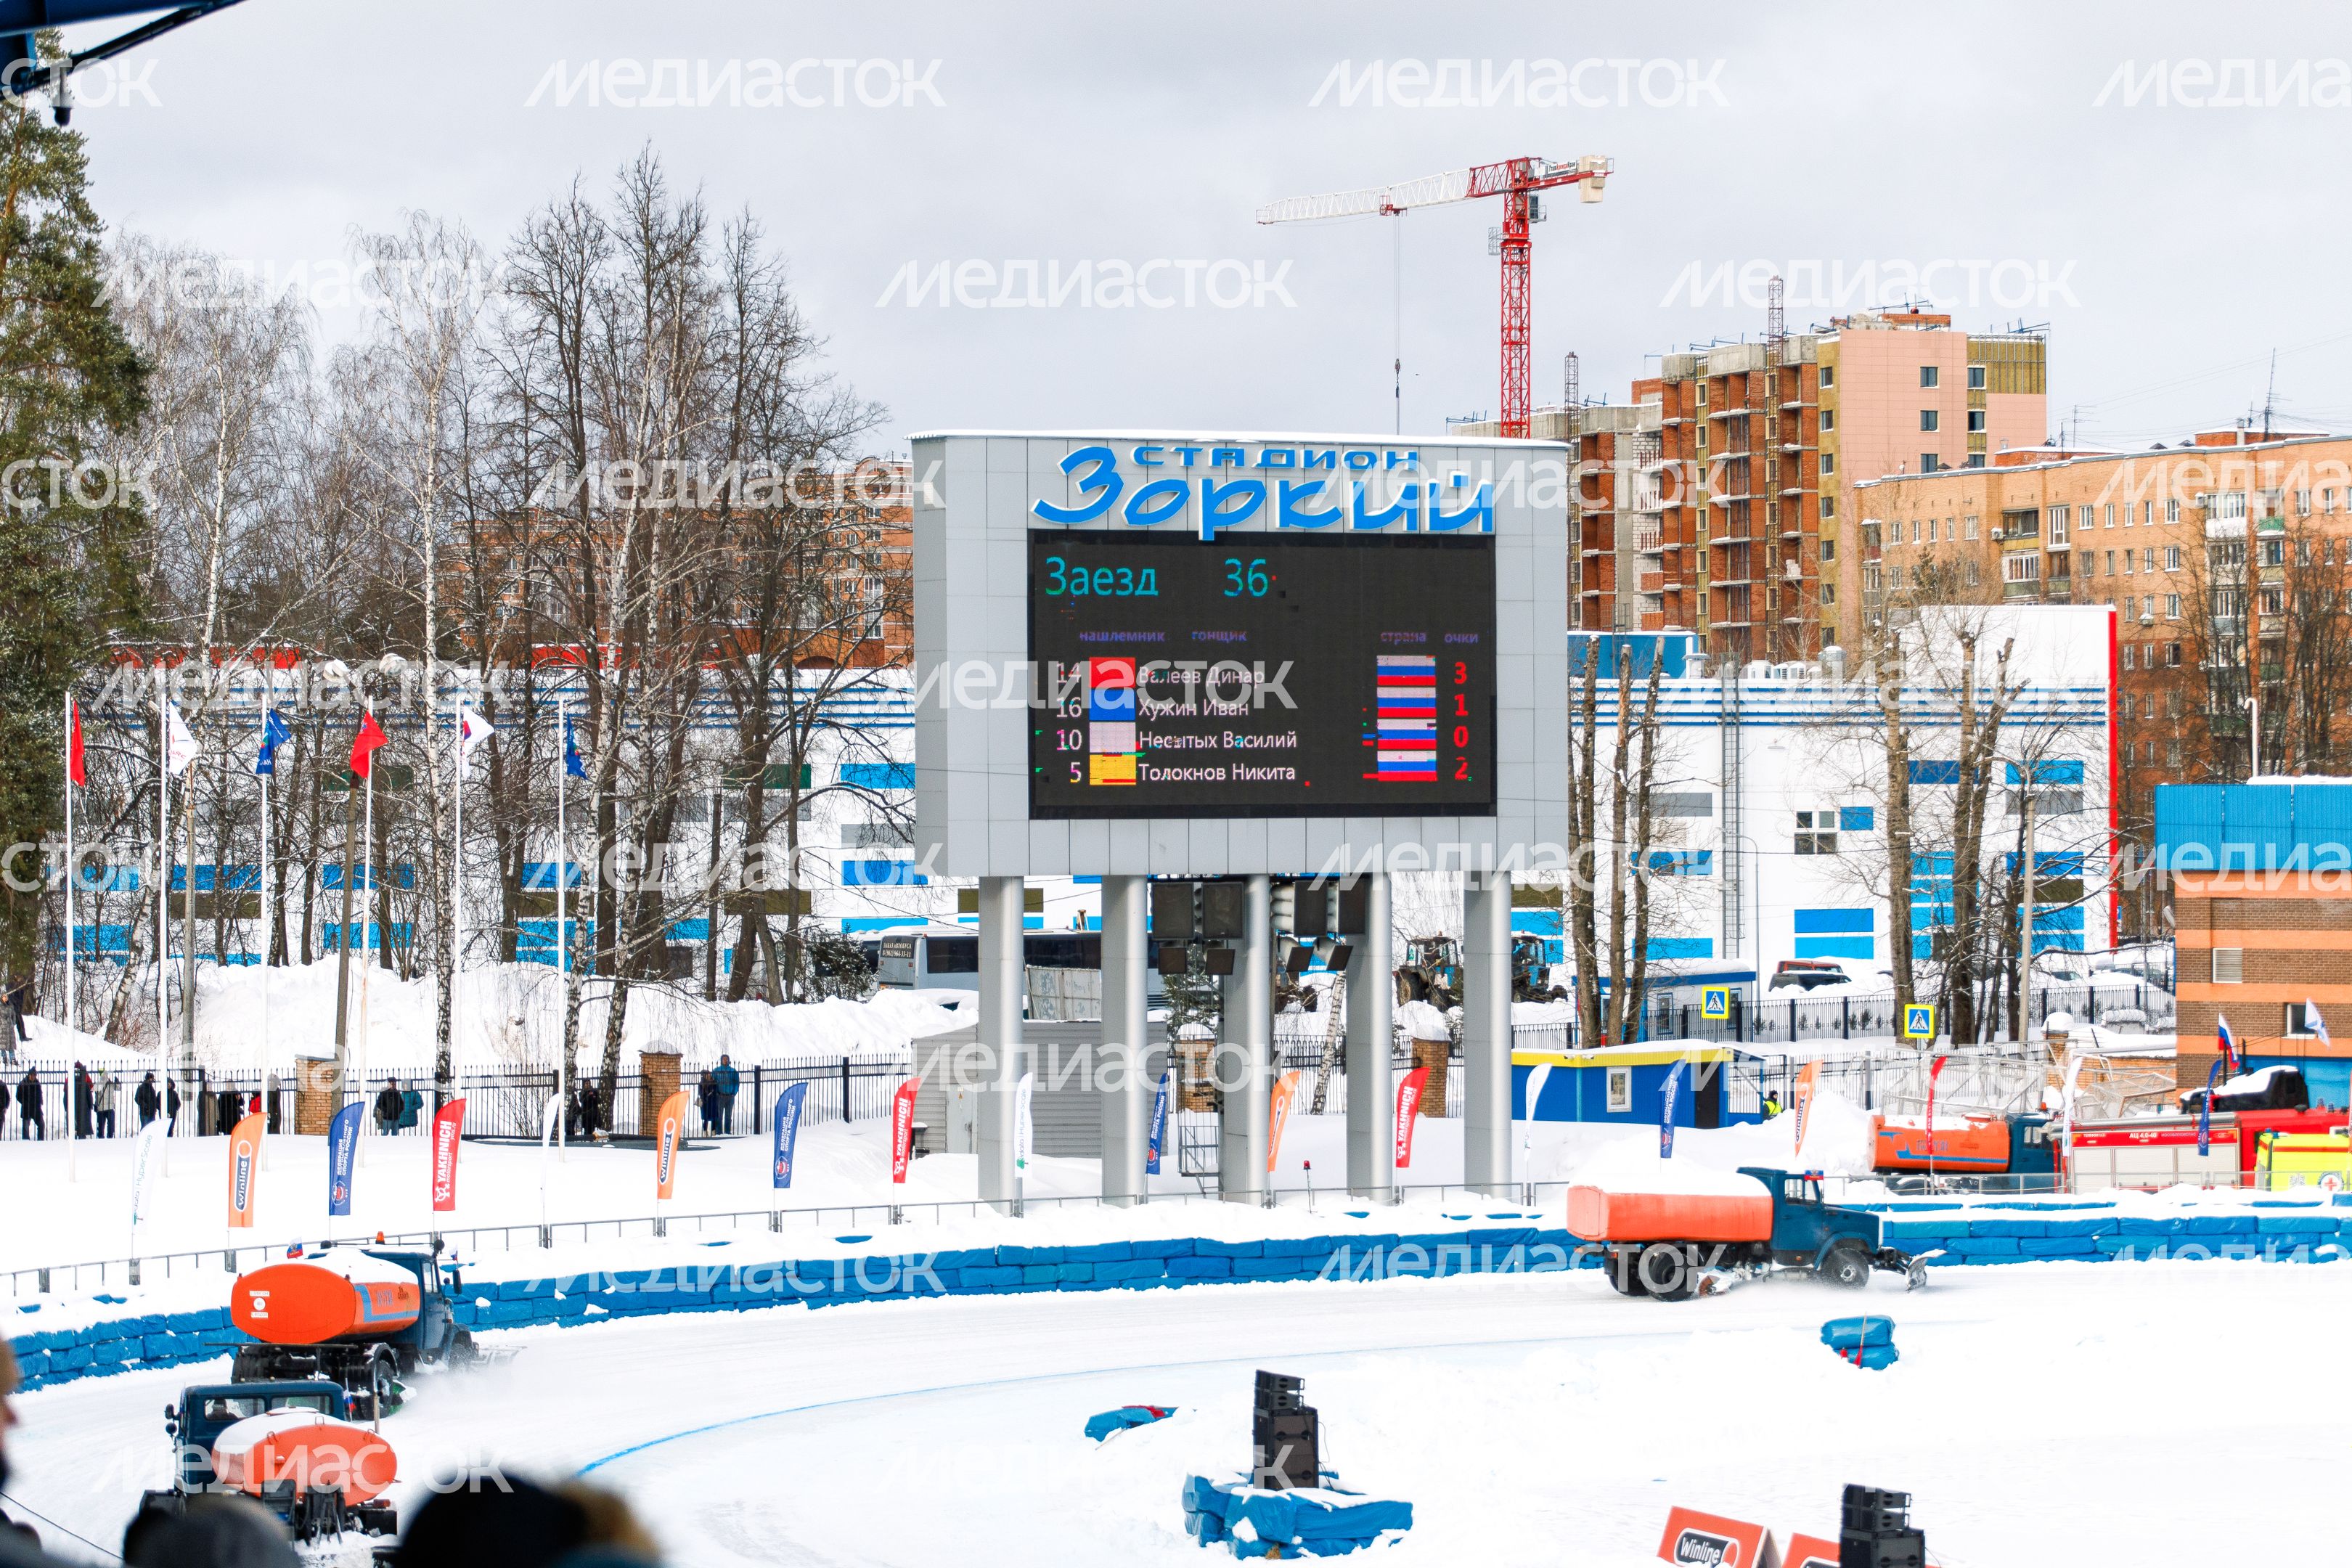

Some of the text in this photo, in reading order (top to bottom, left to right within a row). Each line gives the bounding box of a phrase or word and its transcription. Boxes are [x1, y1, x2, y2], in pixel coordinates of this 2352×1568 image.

[1130, 446, 1419, 470] СТАДИОН
[1032, 446, 1494, 541] Зоркий
[1045, 556, 1269, 597] Заезд 36
[1079, 631, 1479, 645] нашлемник гонщик страна очки
[1055, 662, 1082, 685] 14
[1205, 666, 1265, 689] Динар
[1454, 661, 1467, 685] 3
[1055, 694, 1469, 721] 16 Хужин Иван 1
[1055, 726, 1469, 751] 10 Несытых Василий 0
[1069, 756, 1469, 783] 5 Толокнов Никита 2
[788, 1105, 796, 1129] РОССИИ
[1397, 1085, 1413, 1142] YAKHNICH
[345, 1126, 354, 1151] РОССИИ
[436, 1120, 452, 1183] YAKHNICH
